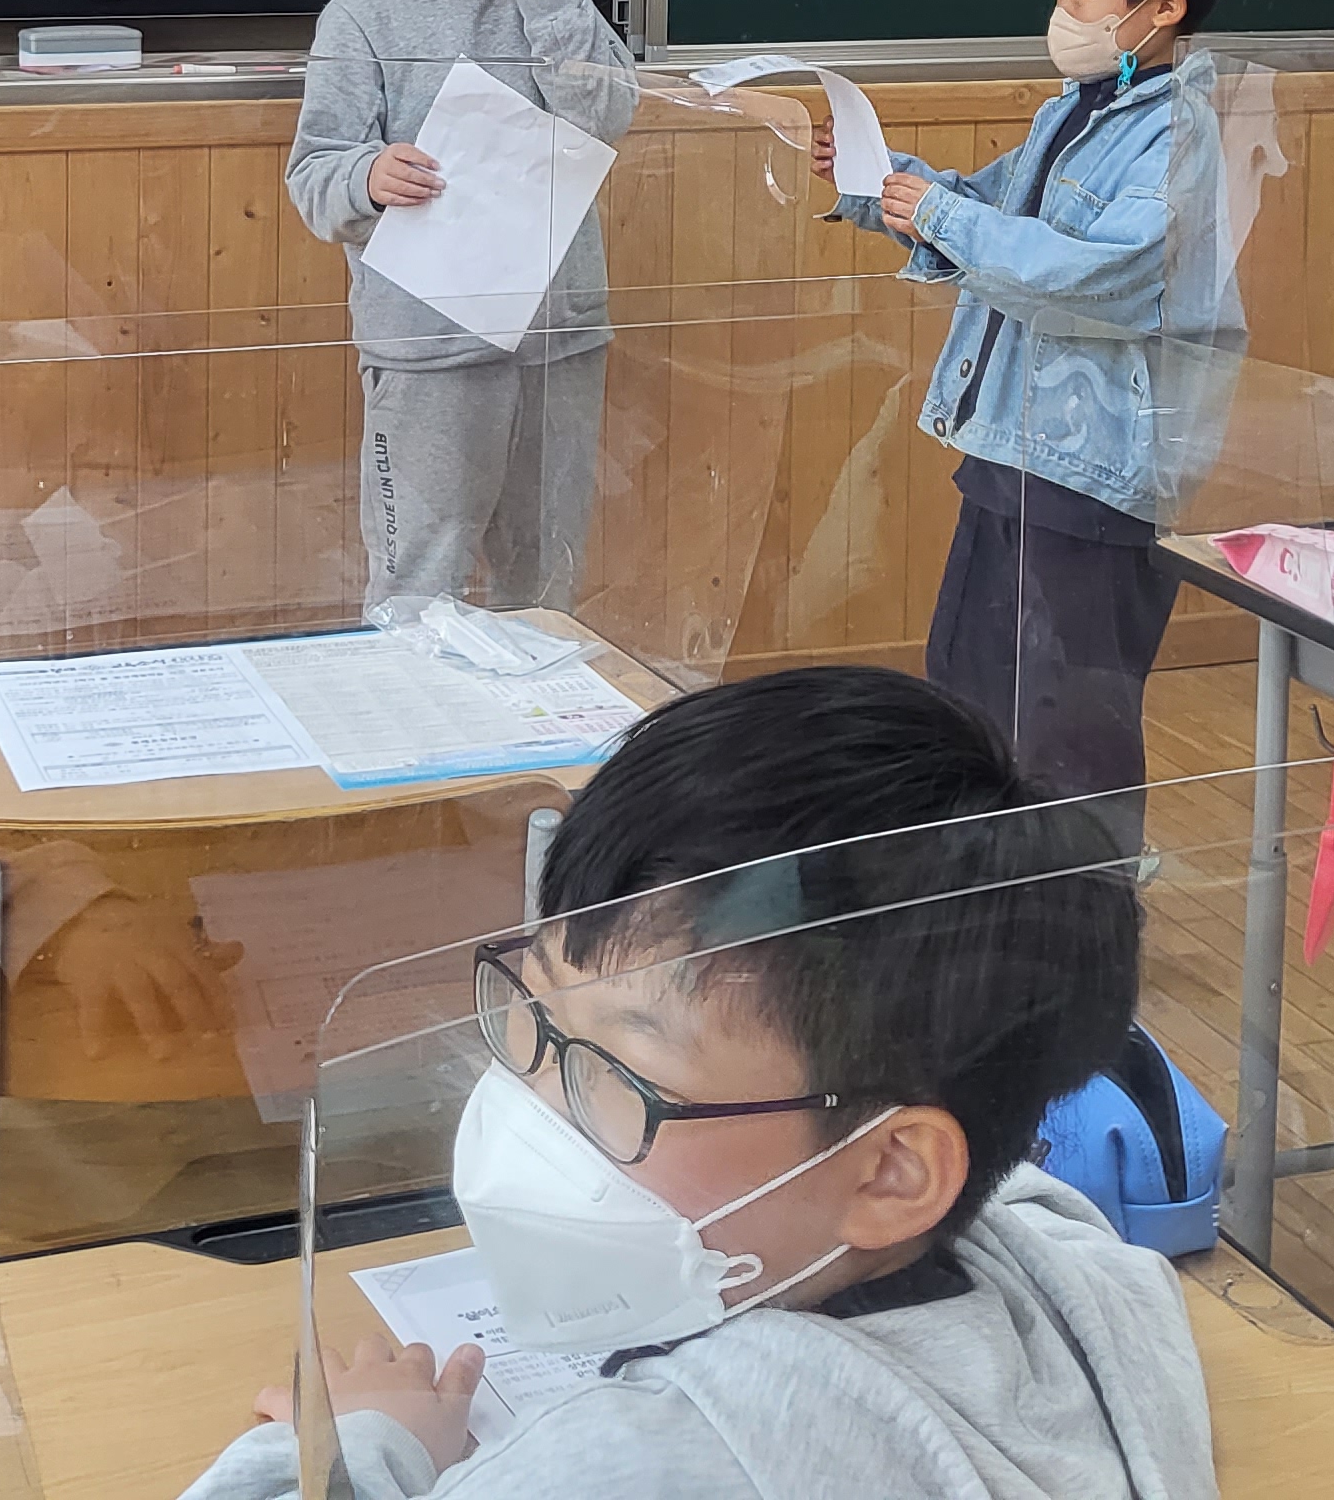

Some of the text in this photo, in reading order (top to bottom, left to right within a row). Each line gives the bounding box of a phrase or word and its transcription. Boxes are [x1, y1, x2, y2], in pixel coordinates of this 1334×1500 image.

[374, 432, 391, 473] CLUB
[380, 476, 394, 499] UN
[384, 502, 398, 535] QUE
